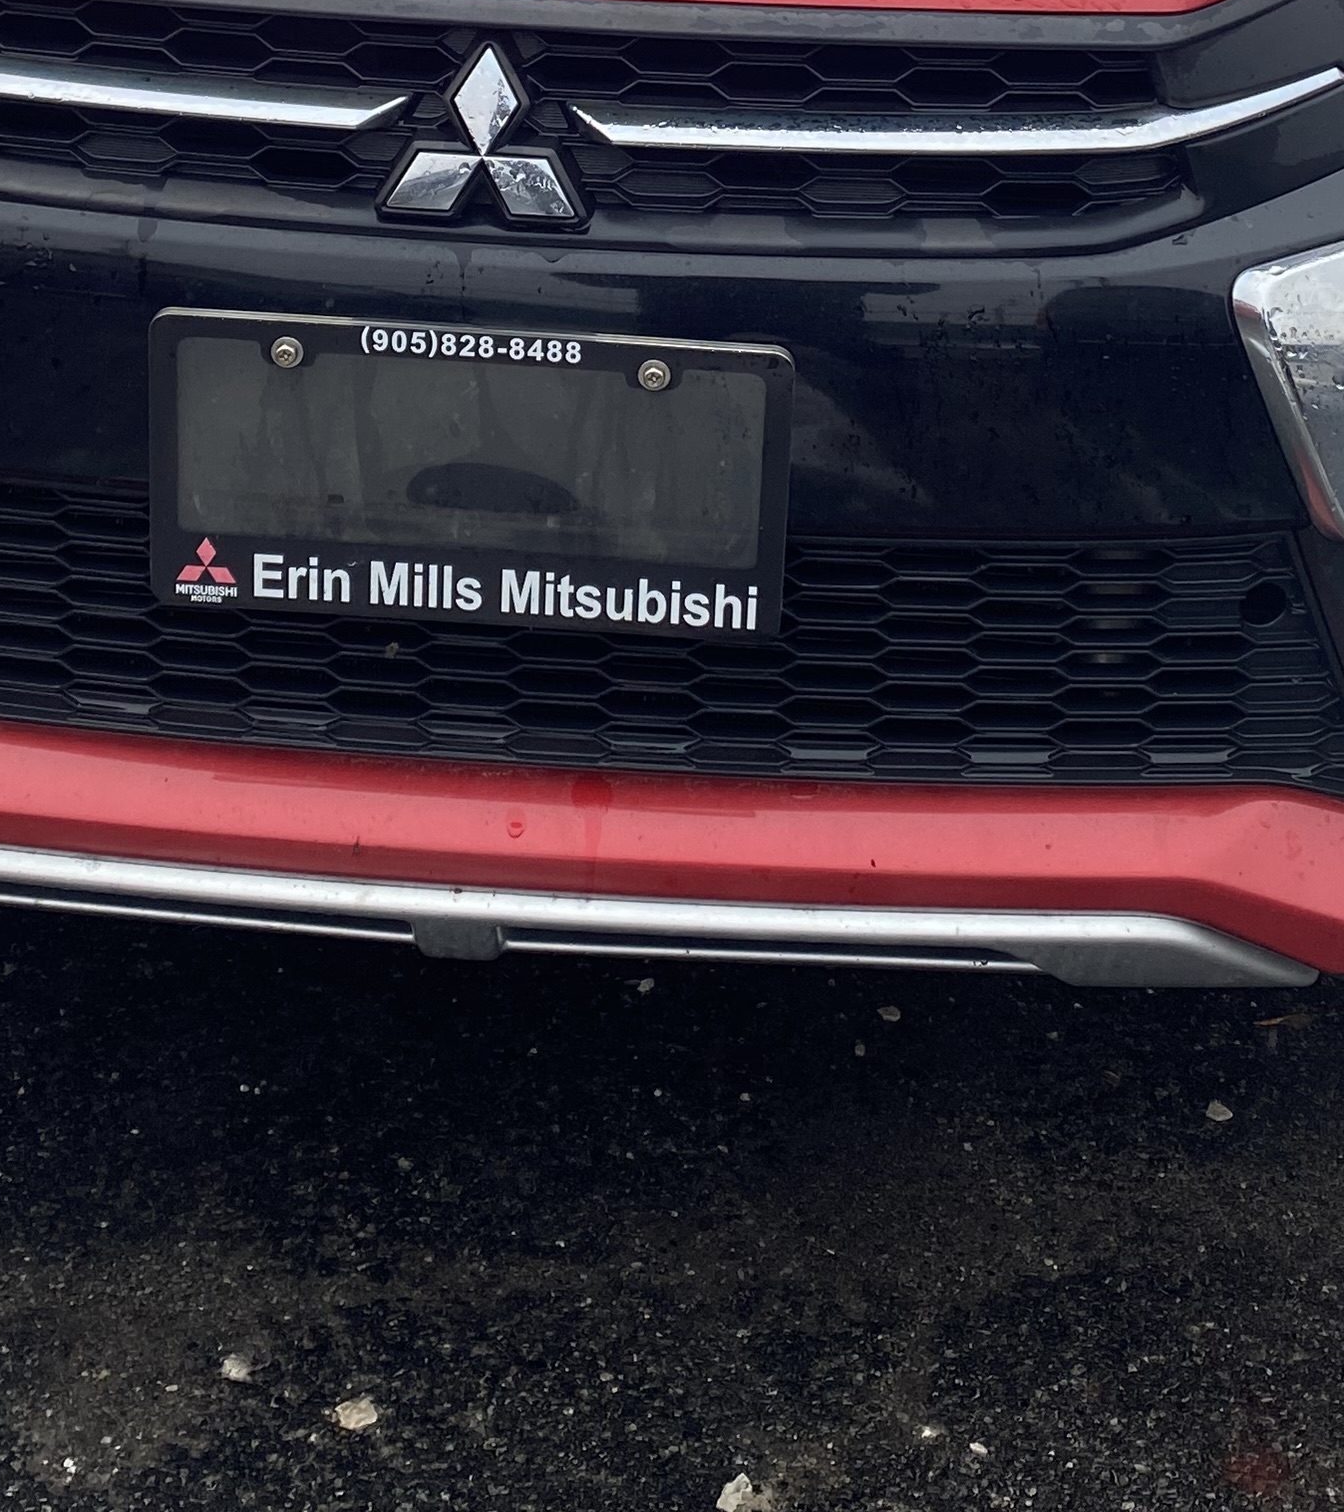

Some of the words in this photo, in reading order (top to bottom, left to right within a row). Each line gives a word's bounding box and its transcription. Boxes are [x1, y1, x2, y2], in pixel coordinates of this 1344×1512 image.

[360, 325, 582, 364] (905)828-8488
[175, 583, 238, 597] MITSUBISHI
[190, 595, 223, 604] MOTORS
[253, 553, 351, 603] Erin
[369, 560, 483, 611] Mills
[500, 569, 758, 631] Mitsubishi
